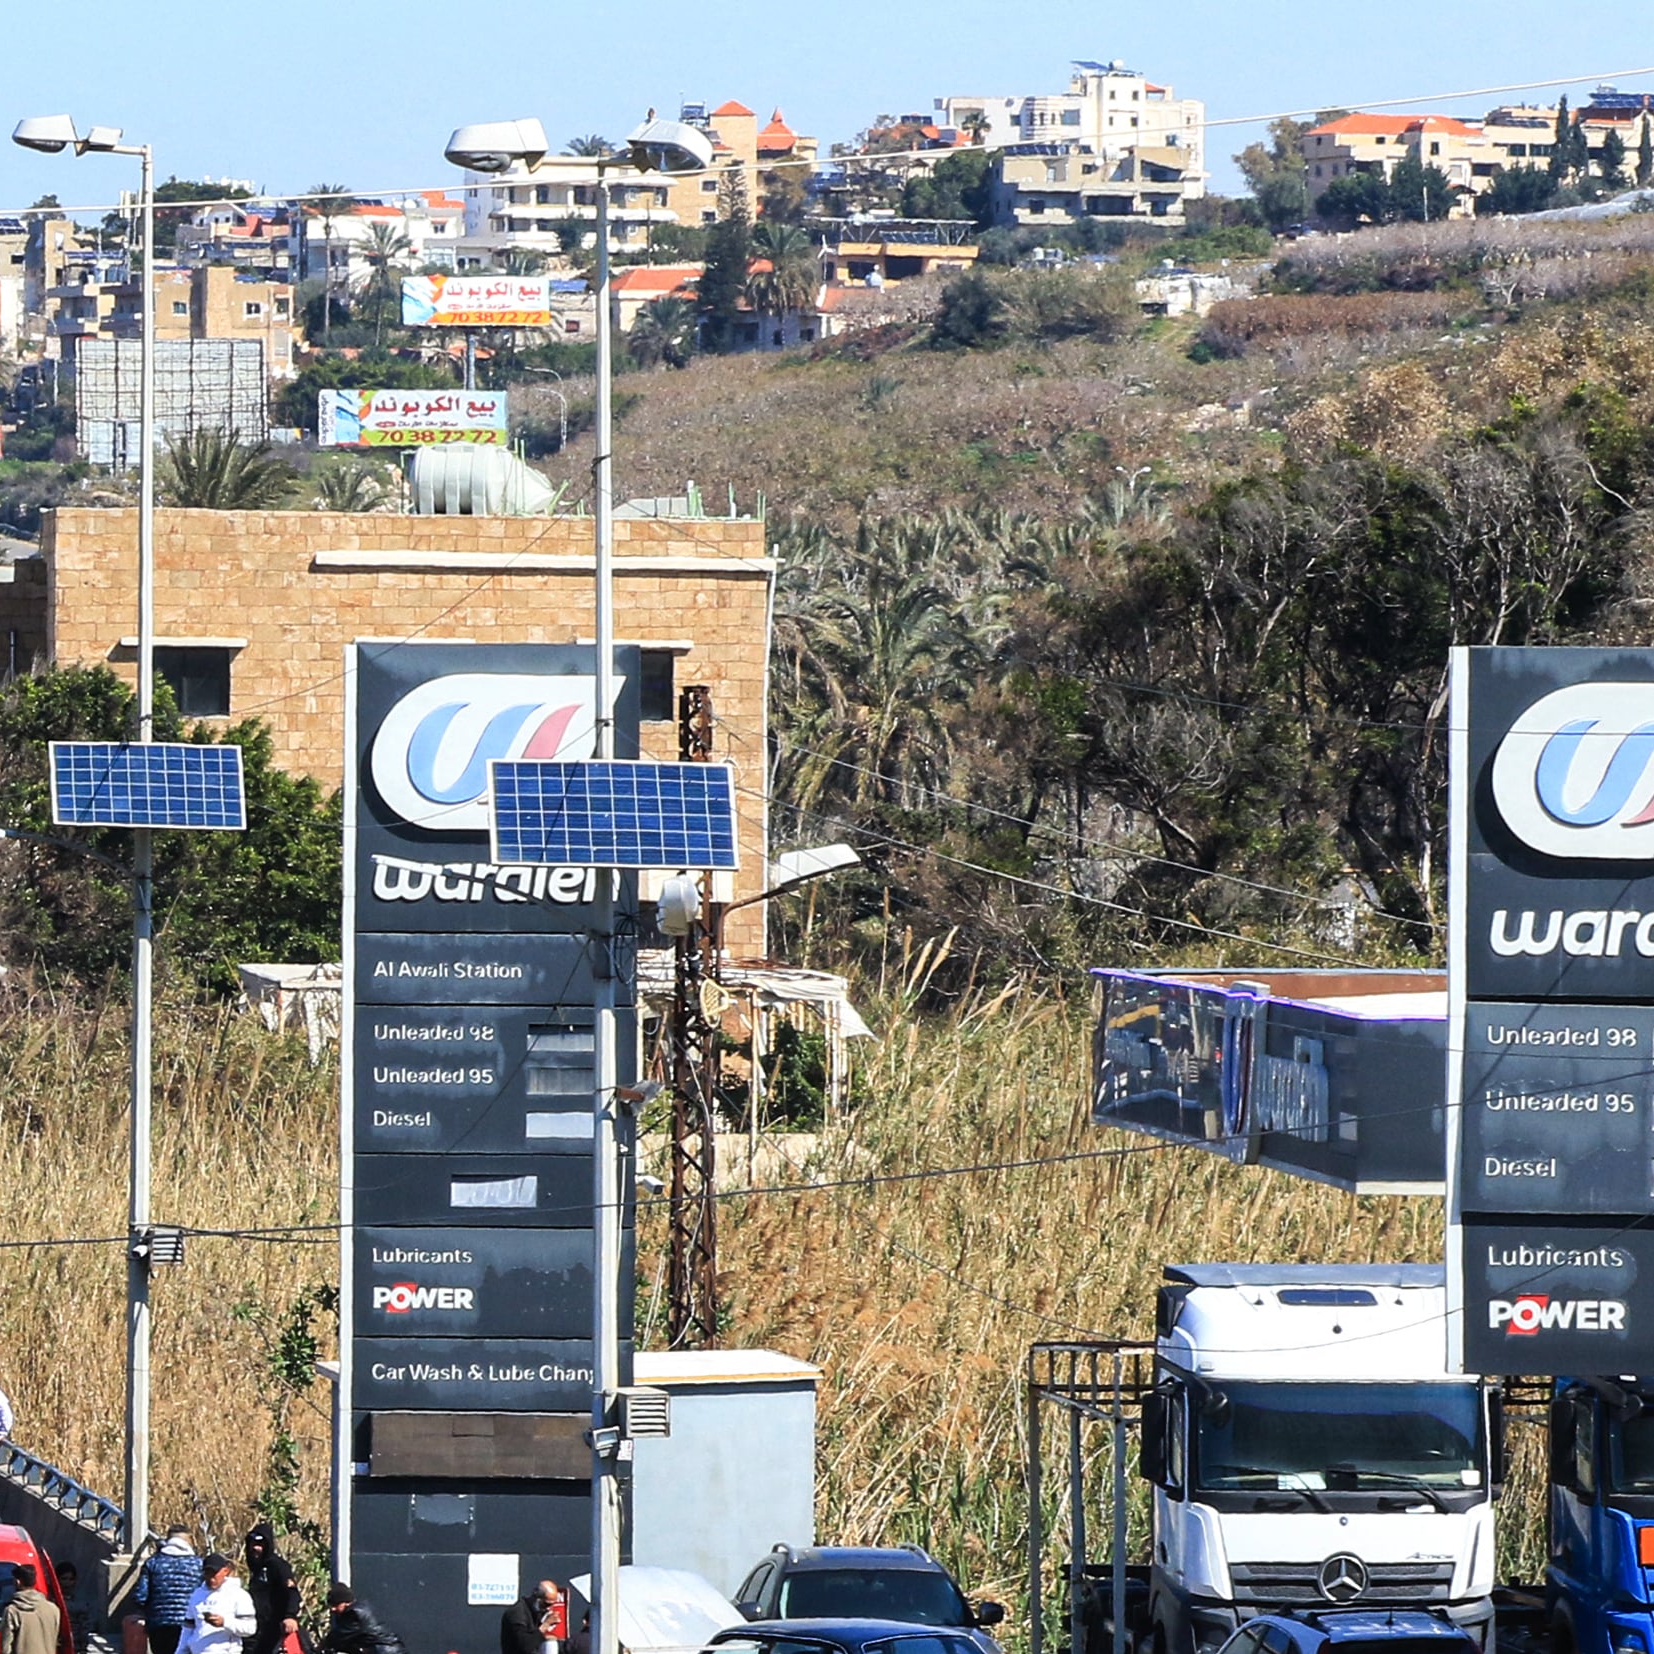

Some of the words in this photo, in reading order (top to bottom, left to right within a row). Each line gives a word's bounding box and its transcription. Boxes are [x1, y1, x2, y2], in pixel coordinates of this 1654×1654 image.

[518, 284, 542, 302] بيع
[450, 311, 469, 323] 70
[519, 311, 543, 323] 72
[466, 400, 496, 418] بيع
[378, 430, 404, 442] 70
[408, 430, 435, 442] 38
[469, 430, 497, 442] 72
[373, 961, 394, 978] Al
[398, 961, 449, 979] Awali
[453, 961, 523, 979] Station
[373, 1025, 464, 1043] Unleaded
[469, 1026, 494, 1043] 98
[1487, 1026, 1600, 1049] Unleaded
[1606, 1028, 1637, 1049] 98
[373, 1068, 464, 1085] Unleaded
[469, 1068, 494, 1085] 95
[1486, 1090, 1600, 1112] Unleaded
[1605, 1093, 1635, 1113] 95
[373, 1110, 432, 1127] Diesel
[1485, 1157, 1557, 1178] Diesel
[372, 1247, 473, 1266] Lubricants
[1489, 1245, 1624, 1269] Lubricants
[372, 1287, 474, 1311] POWER
[1489, 1301, 1625, 1331] POWER
[372, 1364, 405, 1382] Car
[409, 1363, 463, 1382] Wash
[468, 1364, 485, 1382] &
[489, 1364, 535, 1382] Lube
